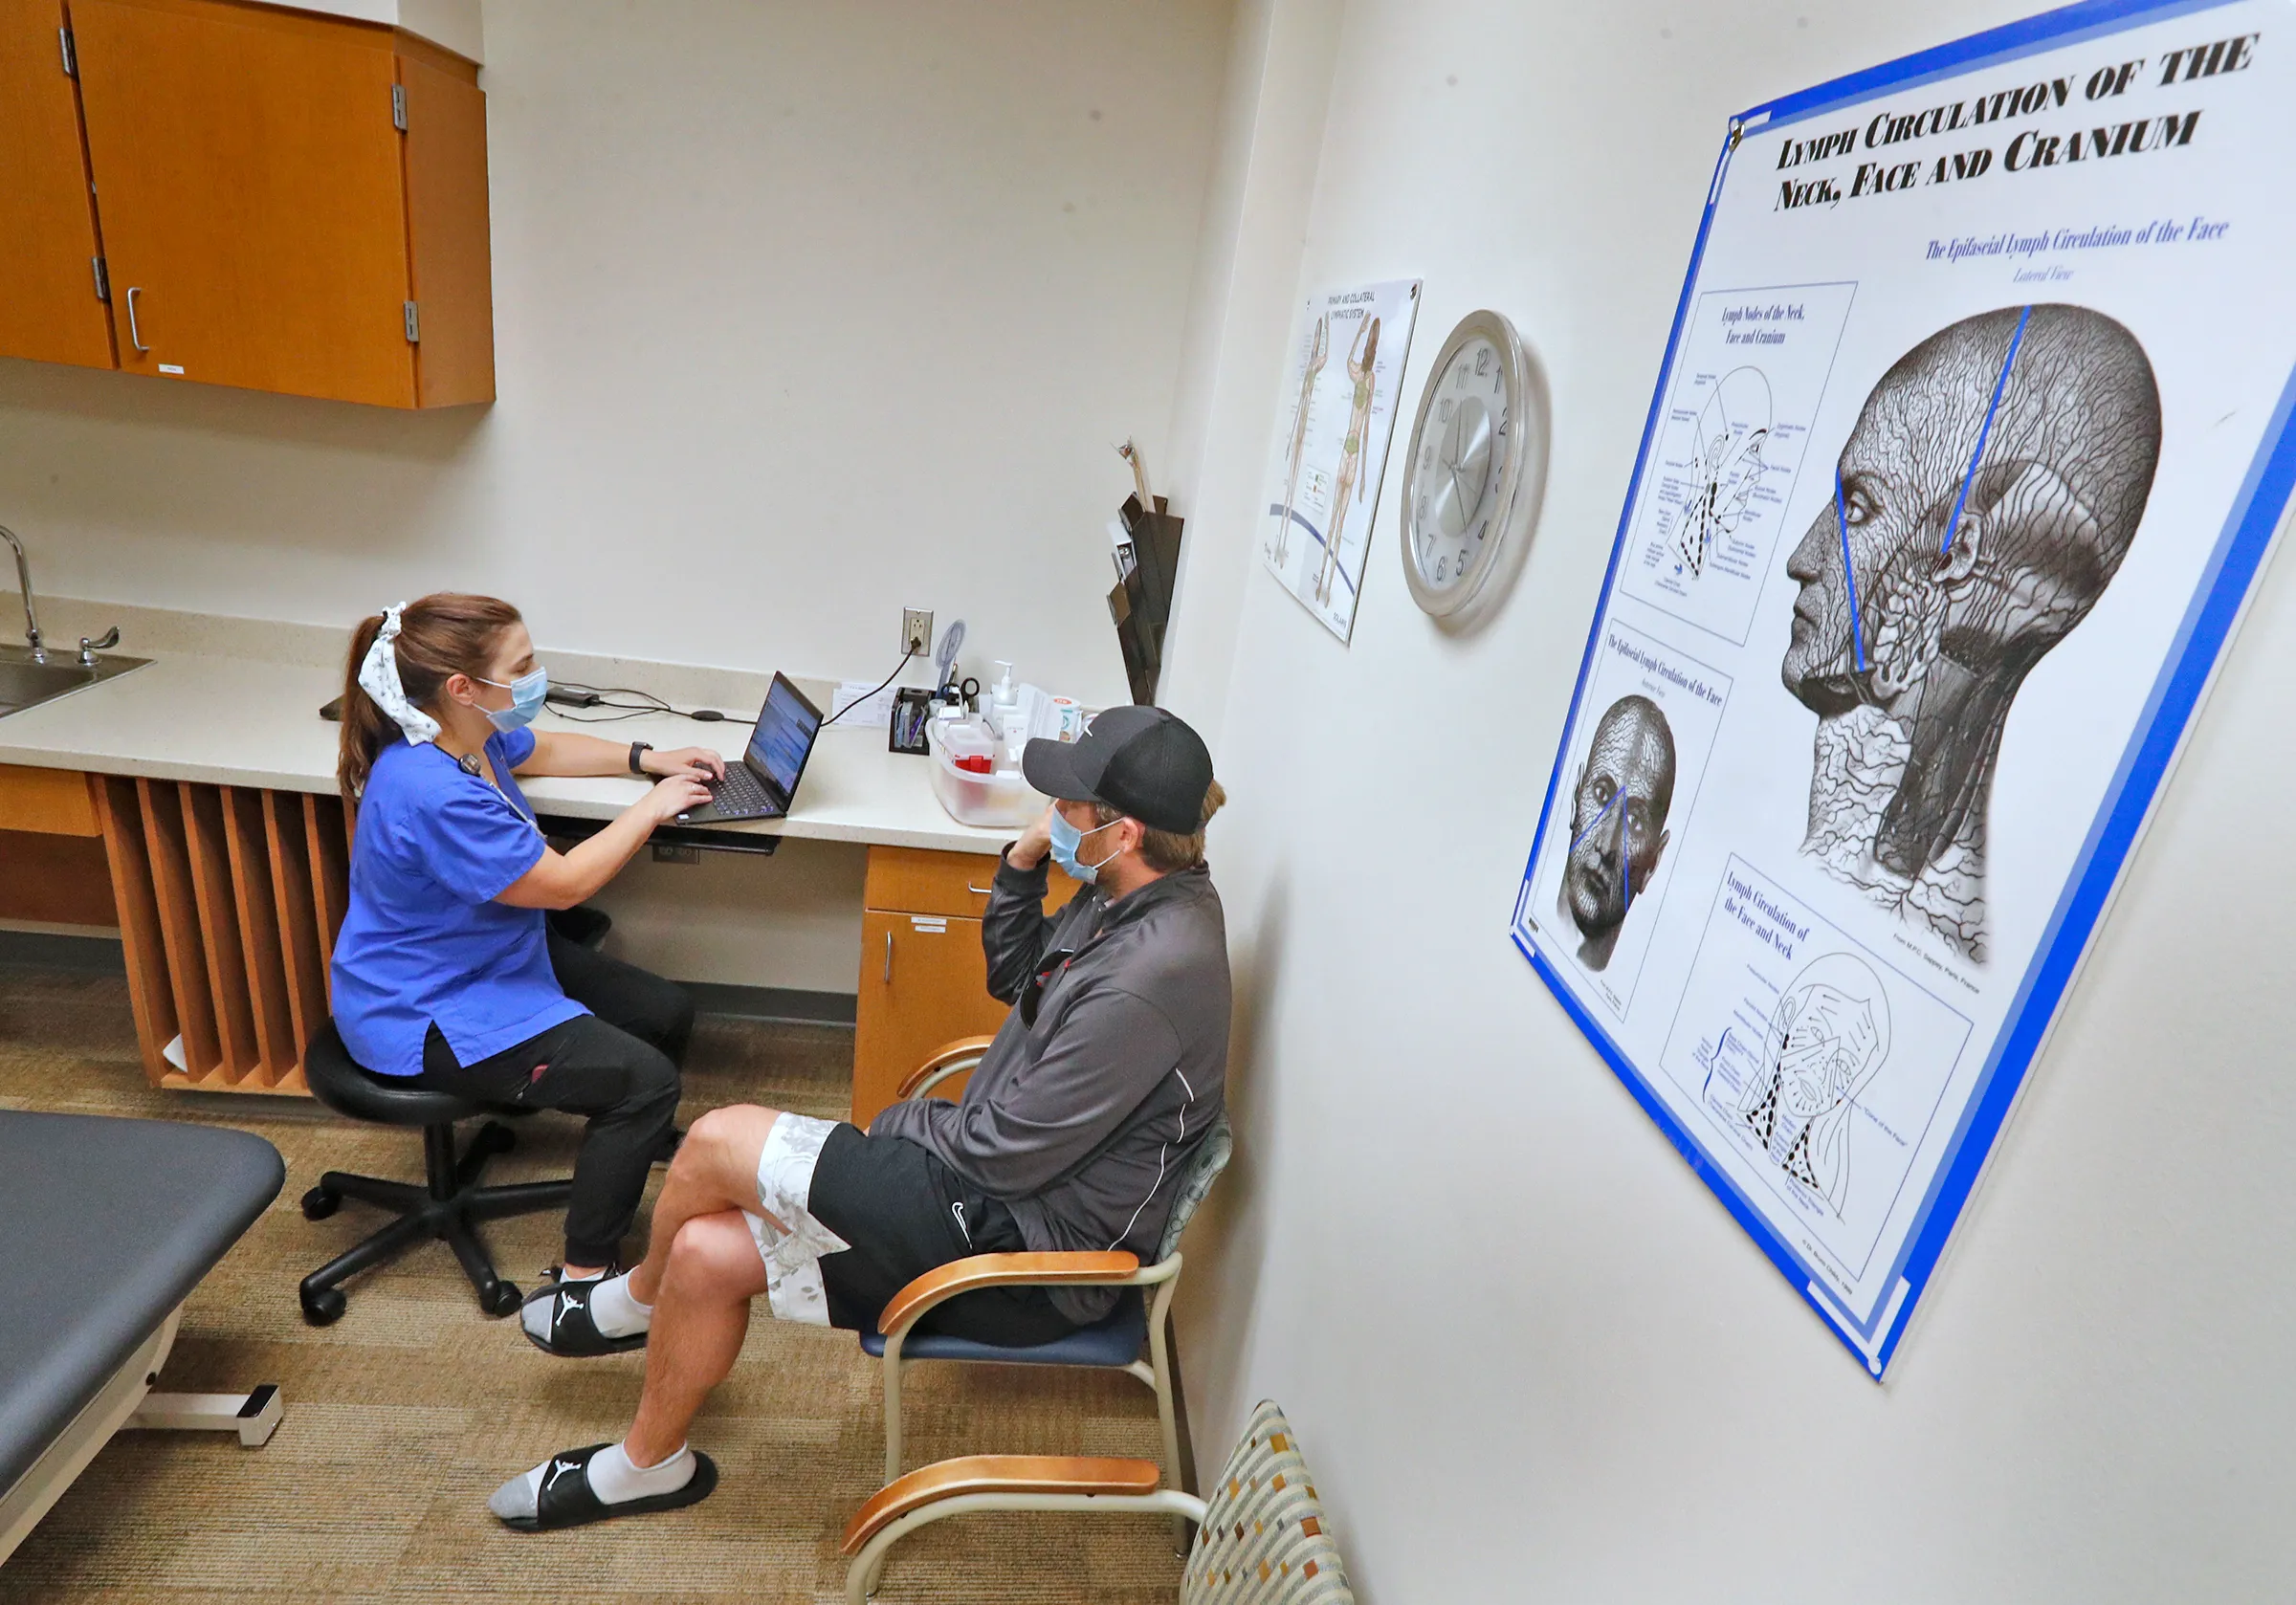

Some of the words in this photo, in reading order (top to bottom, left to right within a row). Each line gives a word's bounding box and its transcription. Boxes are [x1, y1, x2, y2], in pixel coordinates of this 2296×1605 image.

[1776, 126, 1859, 170] LYMPH
[1865, 75, 2077, 148] CIRCULATION
[2086, 58, 2146, 101] OF
[2156, 32, 2261, 87] THE
[1774, 177, 1842, 211] NECK,
[1848, 162, 1922, 198] FACE
[1926, 148, 1993, 186] AND
[2004, 108, 2205, 171] CRANIUM
[1926, 239, 1946, 260] The
[1947, 233, 2006, 264] Epifascial
[2005, 230, 2050, 259] Lymph
[2052, 225, 2132, 250] Circulation
[2135, 220, 2158, 244] of
[2155, 219, 2184, 243] the
[2187, 216, 2230, 241] Face
[1475, 347, 1490, 377] 12
[1439, 398, 1452, 423] 10
[1425, 534, 1435, 558] 7
[1456, 549, 1467, 576] 5
[1436, 556, 1446, 582] 6
[1727, 870, 1753, 900] Lymph
[1753, 890, 1797, 934] Circulation
[1797, 928, 1810, 942] of
[1724, 897, 1737, 914] the
[1737, 905, 1755, 930] Face
[1755, 925, 1774, 943] and
[1773, 933, 1793, 960] Neck
